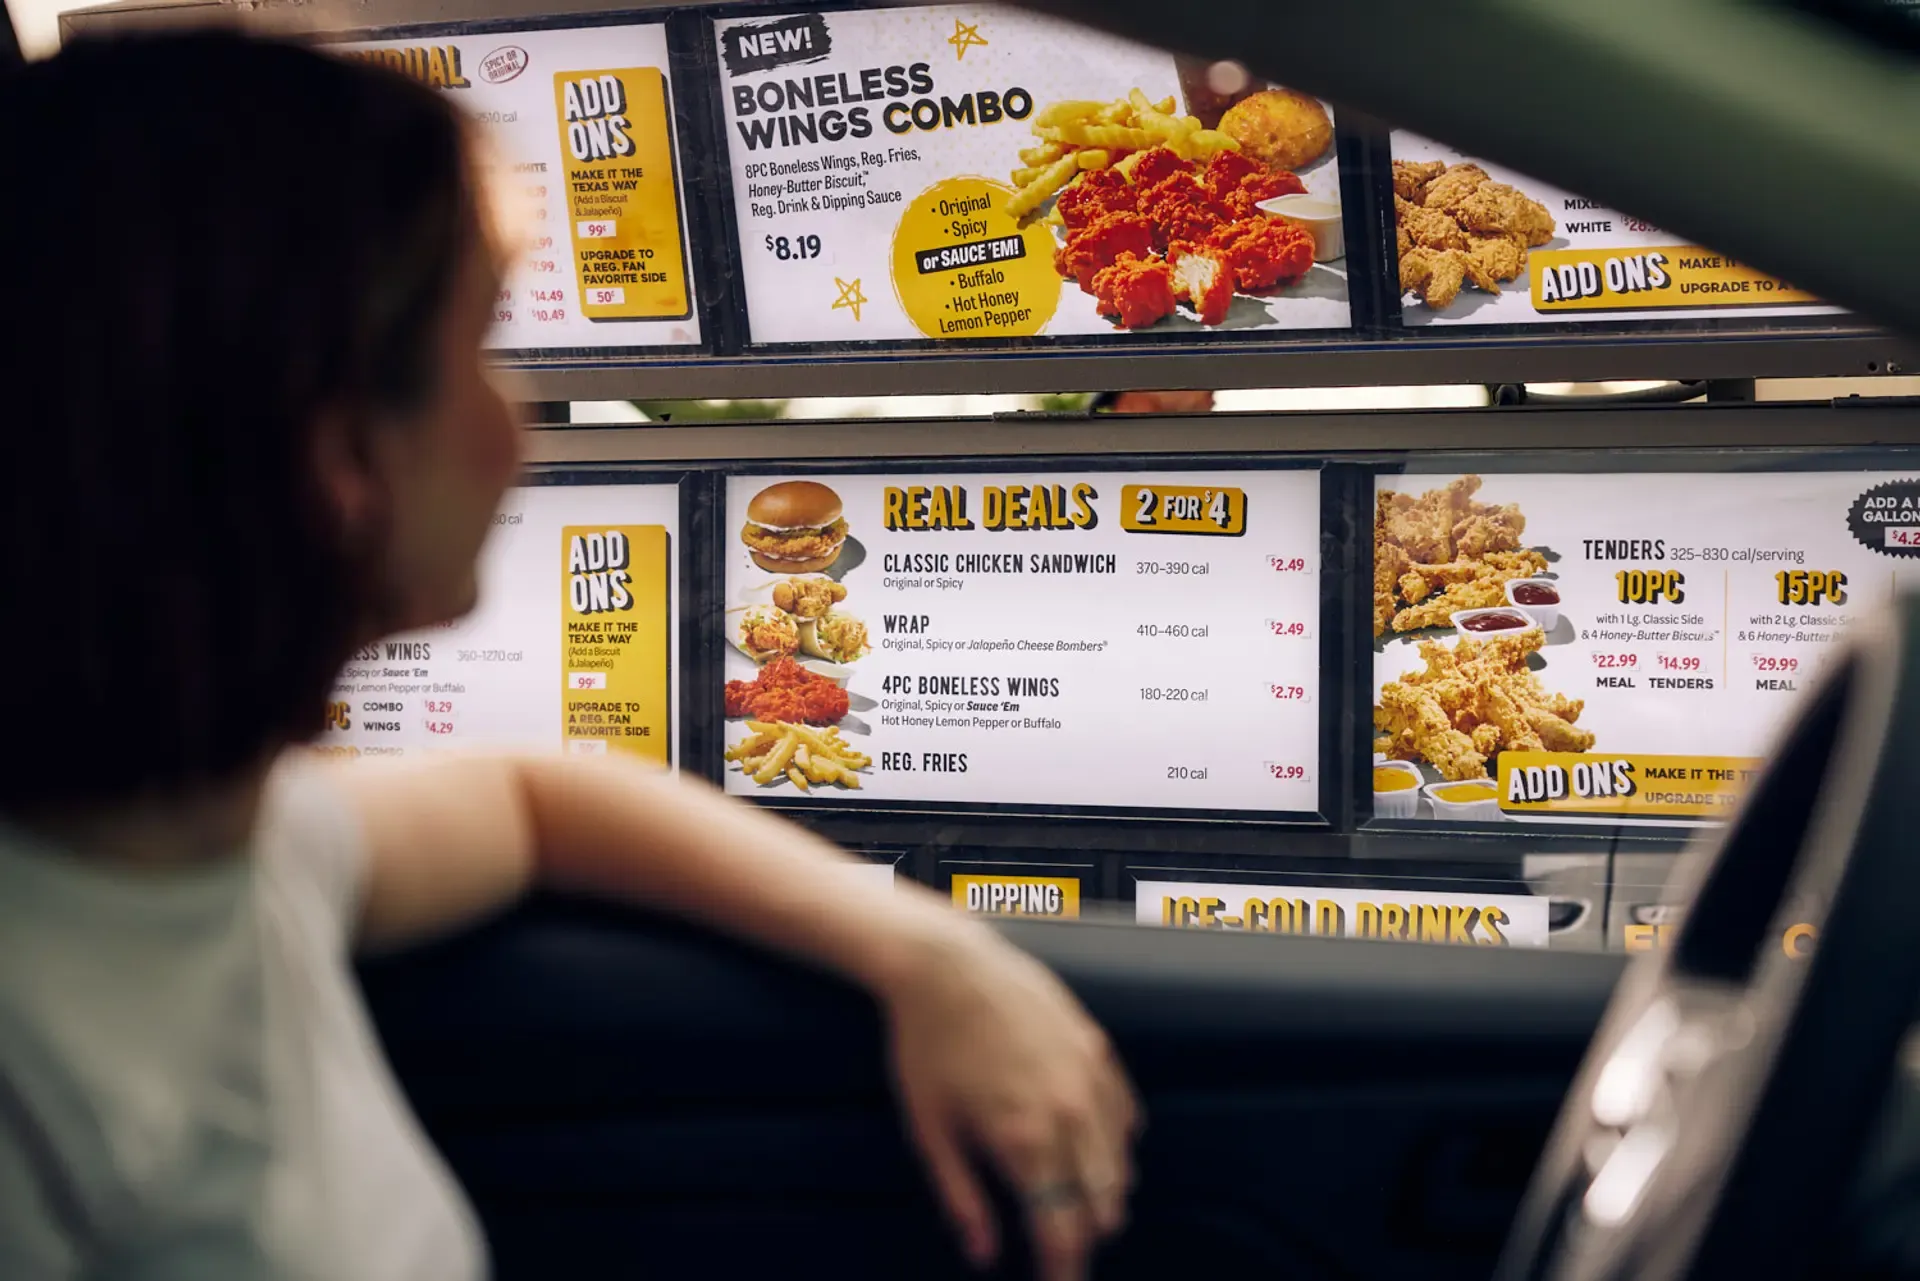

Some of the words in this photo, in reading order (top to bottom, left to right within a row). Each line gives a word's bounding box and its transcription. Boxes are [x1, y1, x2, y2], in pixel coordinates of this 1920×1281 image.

[738, 27, 813, 58] NEW!
[732, 62, 934, 117] BONELESS
[564, 74, 625, 121] ADD
[736, 107, 873, 151] WINGS
[882, 87, 1034, 136] COMBO
[568, 115, 634, 161] ONS
[745, 163, 768, 179] 8PC
[770, 159, 820, 176] Boneless
[821, 155, 860, 171] Wings,
[861, 151, 887, 168] Reg.
[888, 148, 921, 163] Fries,
[571, 169, 604, 181] MAKE
[608, 168, 617, 179] IT
[622, 168, 643, 178] THE
[572, 181, 608, 193] TEXAS
[614, 180, 638, 191] WAY
[749, 178, 823, 198] Honey-Butter
[600, 194, 628, 204] Biscuit
[751, 202, 776, 219] Reg.
[777, 199, 809, 214] Drink
[811, 197, 821, 211] &
[822, 193, 865, 212] Dipping
[866, 190, 902, 205] Sauce
[939, 193, 991, 217] Original
[951, 219, 987, 240] Spicy
[1565, 221, 1612, 233] WHITE
[581, 250, 635, 261] UPGRADE
[638, 249, 654, 259] TO
[765, 234, 822, 261] $8.19
[923, 254, 939, 270] or
[940, 243, 986, 267] SAUCE
[1679, 258, 1720, 270] MAKE
[594, 262, 620, 272] REG.
[623, 261, 646, 271] FAN
[584, 273, 637, 285] FAVORITE
[642, 272, 667, 283] SIDE
[957, 268, 1004, 289] Buffalo
[1541, 263, 1603, 302] ADD
[1605, 253, 1671, 294] ONS
[1680, 281, 1750, 294] UPGRADE
[1754, 280, 1773, 291] TO
[953, 296, 977, 312] Hot
[978, 291, 1019, 308] Honey
[939, 317, 983, 334] Lemon
[984, 307, 1032, 327] Pepper
[884, 485, 974, 532] REAL
[983, 483, 1098, 531] DEALS
[1136, 489, 1158, 525] 2
[1163, 496, 1203, 521] FOR
[1204, 489, 1231, 528] $4
[1864, 497, 1897, 509] ADD
[1901, 497, 1913, 508] A
[1862, 511, 1920, 522] GALLON
[569, 531, 629, 574] ADD
[1583, 539, 1665, 560] TENDERS
[1670, 548, 1728, 561] 325-830
[1731, 547, 1804, 564] cal/serving
[884, 554, 949, 573] CLASSIC
[956, 554, 1023, 573] CHICKEN
[1030, 554, 1116, 574] SANDWICH
[1136, 561, 1188, 576] 370-390
[1192, 561, 1209, 576] cal
[1271, 557, 1305, 573] $2.49
[883, 577, 922, 590] Original
[924, 580, 934, 588] or
[936, 577, 964, 590] Spicy
[1615, 569, 1685, 605] 10PC
[1774, 570, 1848, 606] 15PC
[570, 570, 634, 614] ONS
[569, 622, 600, 632] MAKE
[604, 622, 613, 632] IT
[617, 622, 638, 632] THE
[884, 615, 930, 633] WRAP
[1596, 614, 1619, 625] with
[1627, 614, 1641, 628] Lg.
[1643, 613, 1679, 625] Classic
[1681, 614, 1704, 625] Side
[1750, 614, 1773, 625] with
[1783, 615, 1798, 629] Lg.
[1799, 614, 1837, 625] Classic
[1136, 624, 1188, 638] 410-460
[1192, 624, 1209, 639] cal
[1270, 621, 1305, 636] $2.49
[569, 634, 603, 644] TEXAS
[607, 634, 632, 644] WAY
[1581, 631, 1590, 641] &
[1600, 630, 1671, 643] Honey-Butter
[1738, 631, 1747, 641] &
[1757, 631, 1830, 644] Honey-Butter
[386, 643, 431, 661] WINGS
[594, 647, 621, 656] Biscuit
[882, 638, 924, 651] Original,
[926, 639, 953, 652] Spicy
[955, 641, 966, 650] or
[967, 639, 1015, 652] Jalapeño
[1016, 640, 1054, 651] Cheese
[508, 650, 523, 662] cal
[1592, 654, 1637, 669] $22.99
[1658, 655, 1700, 671] $14.99
[1753, 656, 1798, 671] $29.99
[346, 668, 370, 679] Spicy
[382, 668, 409, 677] Sauce
[356, 683, 387, 692] Lemon
[388, 683, 420, 693] Pepper
[433, 683, 465, 693] Buffalo
[882, 675, 912, 694] 4PC
[918, 676, 1000, 696] BONELESS
[1007, 677, 1060, 697] WINGS
[1596, 677, 1635, 688] MEAL
[1649, 678, 1714, 690] TENDERS
[1756, 679, 1797, 691] MEAL
[1140, 688, 1188, 702] 180-220
[1191, 688, 1208, 702] cal
[1270, 684, 1305, 700] $2.79
[363, 702, 404, 712] COMBO
[425, 700, 453, 713] $8.29
[569, 702, 622, 712] UPGRADE
[625, 702, 640, 712] TO
[881, 699, 923, 712] Original,
[925, 700, 953, 713] Spicy
[954, 703, 965, 711] or
[966, 701, 998, 712] Sauce
[364, 722, 401, 731] WINGS
[579, 714, 606, 724] REG.
[608, 714, 631, 724] FAN
[881, 715, 900, 726] Hot
[901, 715, 934, 728] Honey
[935, 716, 971, 727] Lemon
[972, 717, 1010, 730] Pepper
[1011, 720, 1022, 729] or
[1024, 717, 1061, 729] Buffalo
[425, 721, 454, 734] $4.29
[569, 726, 621, 736] FAVORITE
[625, 726, 650, 736] SIDE
[882, 752, 916, 771] REG.
[923, 752, 968, 773] FRIES
[1167, 766, 1187, 780] 210
[1190, 766, 1208, 780] cal
[1270, 764, 1305, 780] $2.99
[1646, 768, 1686, 779] MAKE
[1691, 768, 1703, 779] IT
[1708, 769, 1734, 780] THE
[1508, 764, 1568, 803] ADD
[1572, 760, 1637, 798] ONS
[1646, 792, 1713, 805] UPGRADE
[967, 882, 1064, 914] DIPPING
[1356, 902, 1511, 946] DRINKS
